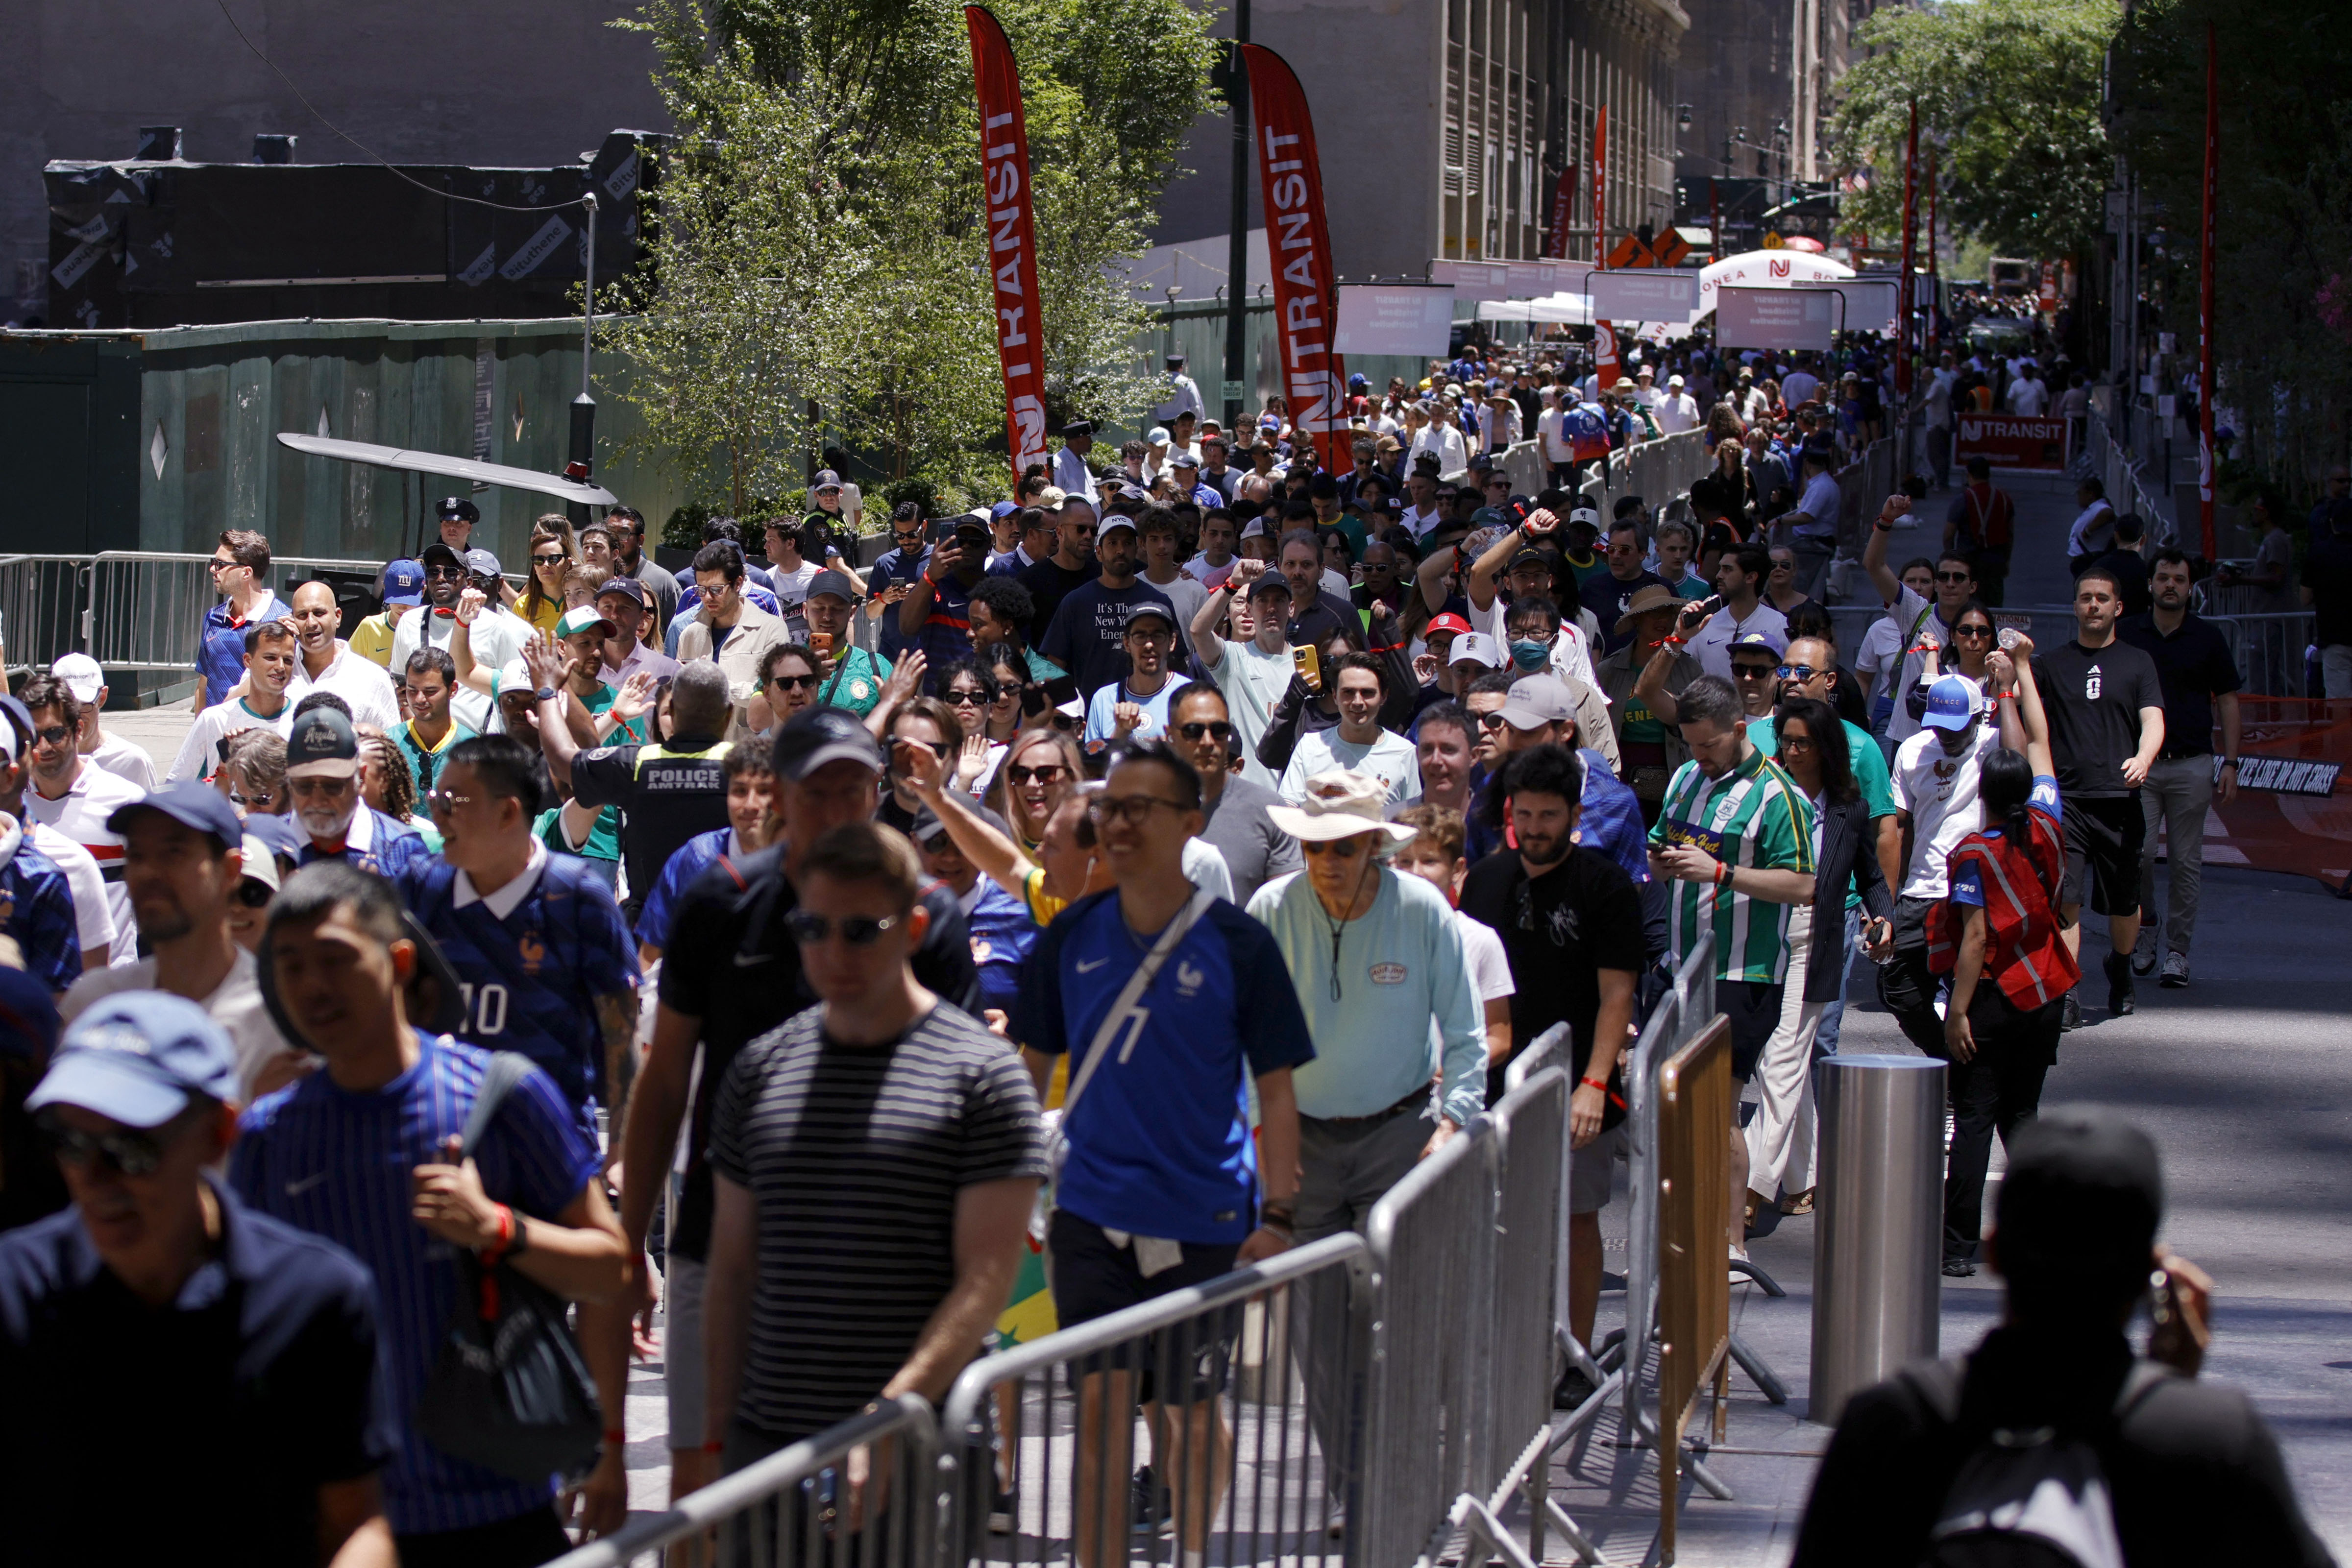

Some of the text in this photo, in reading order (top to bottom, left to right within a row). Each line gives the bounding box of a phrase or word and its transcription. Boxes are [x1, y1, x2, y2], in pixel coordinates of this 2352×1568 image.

[1265, 125, 1325, 368] TRANSIT
[1960, 420, 2062, 442] NJ TRANSIT
[1097, 603, 1113, 613] It's
[1095, 616, 1117, 627] New
[1101, 629, 1124, 641] Ener
[1932, 697, 1960, 706] FRANCE
[648, 770, 720, 782] POLICE
[2251, 759, 2282, 788] LINE
[2272, 761, 2294, 790] DO
[2285, 762, 2313, 792] NOT
[2303, 764, 2339, 795] CROSS
[1697, 834, 1720, 853] Hut
[459, 982, 508, 1035] 10
